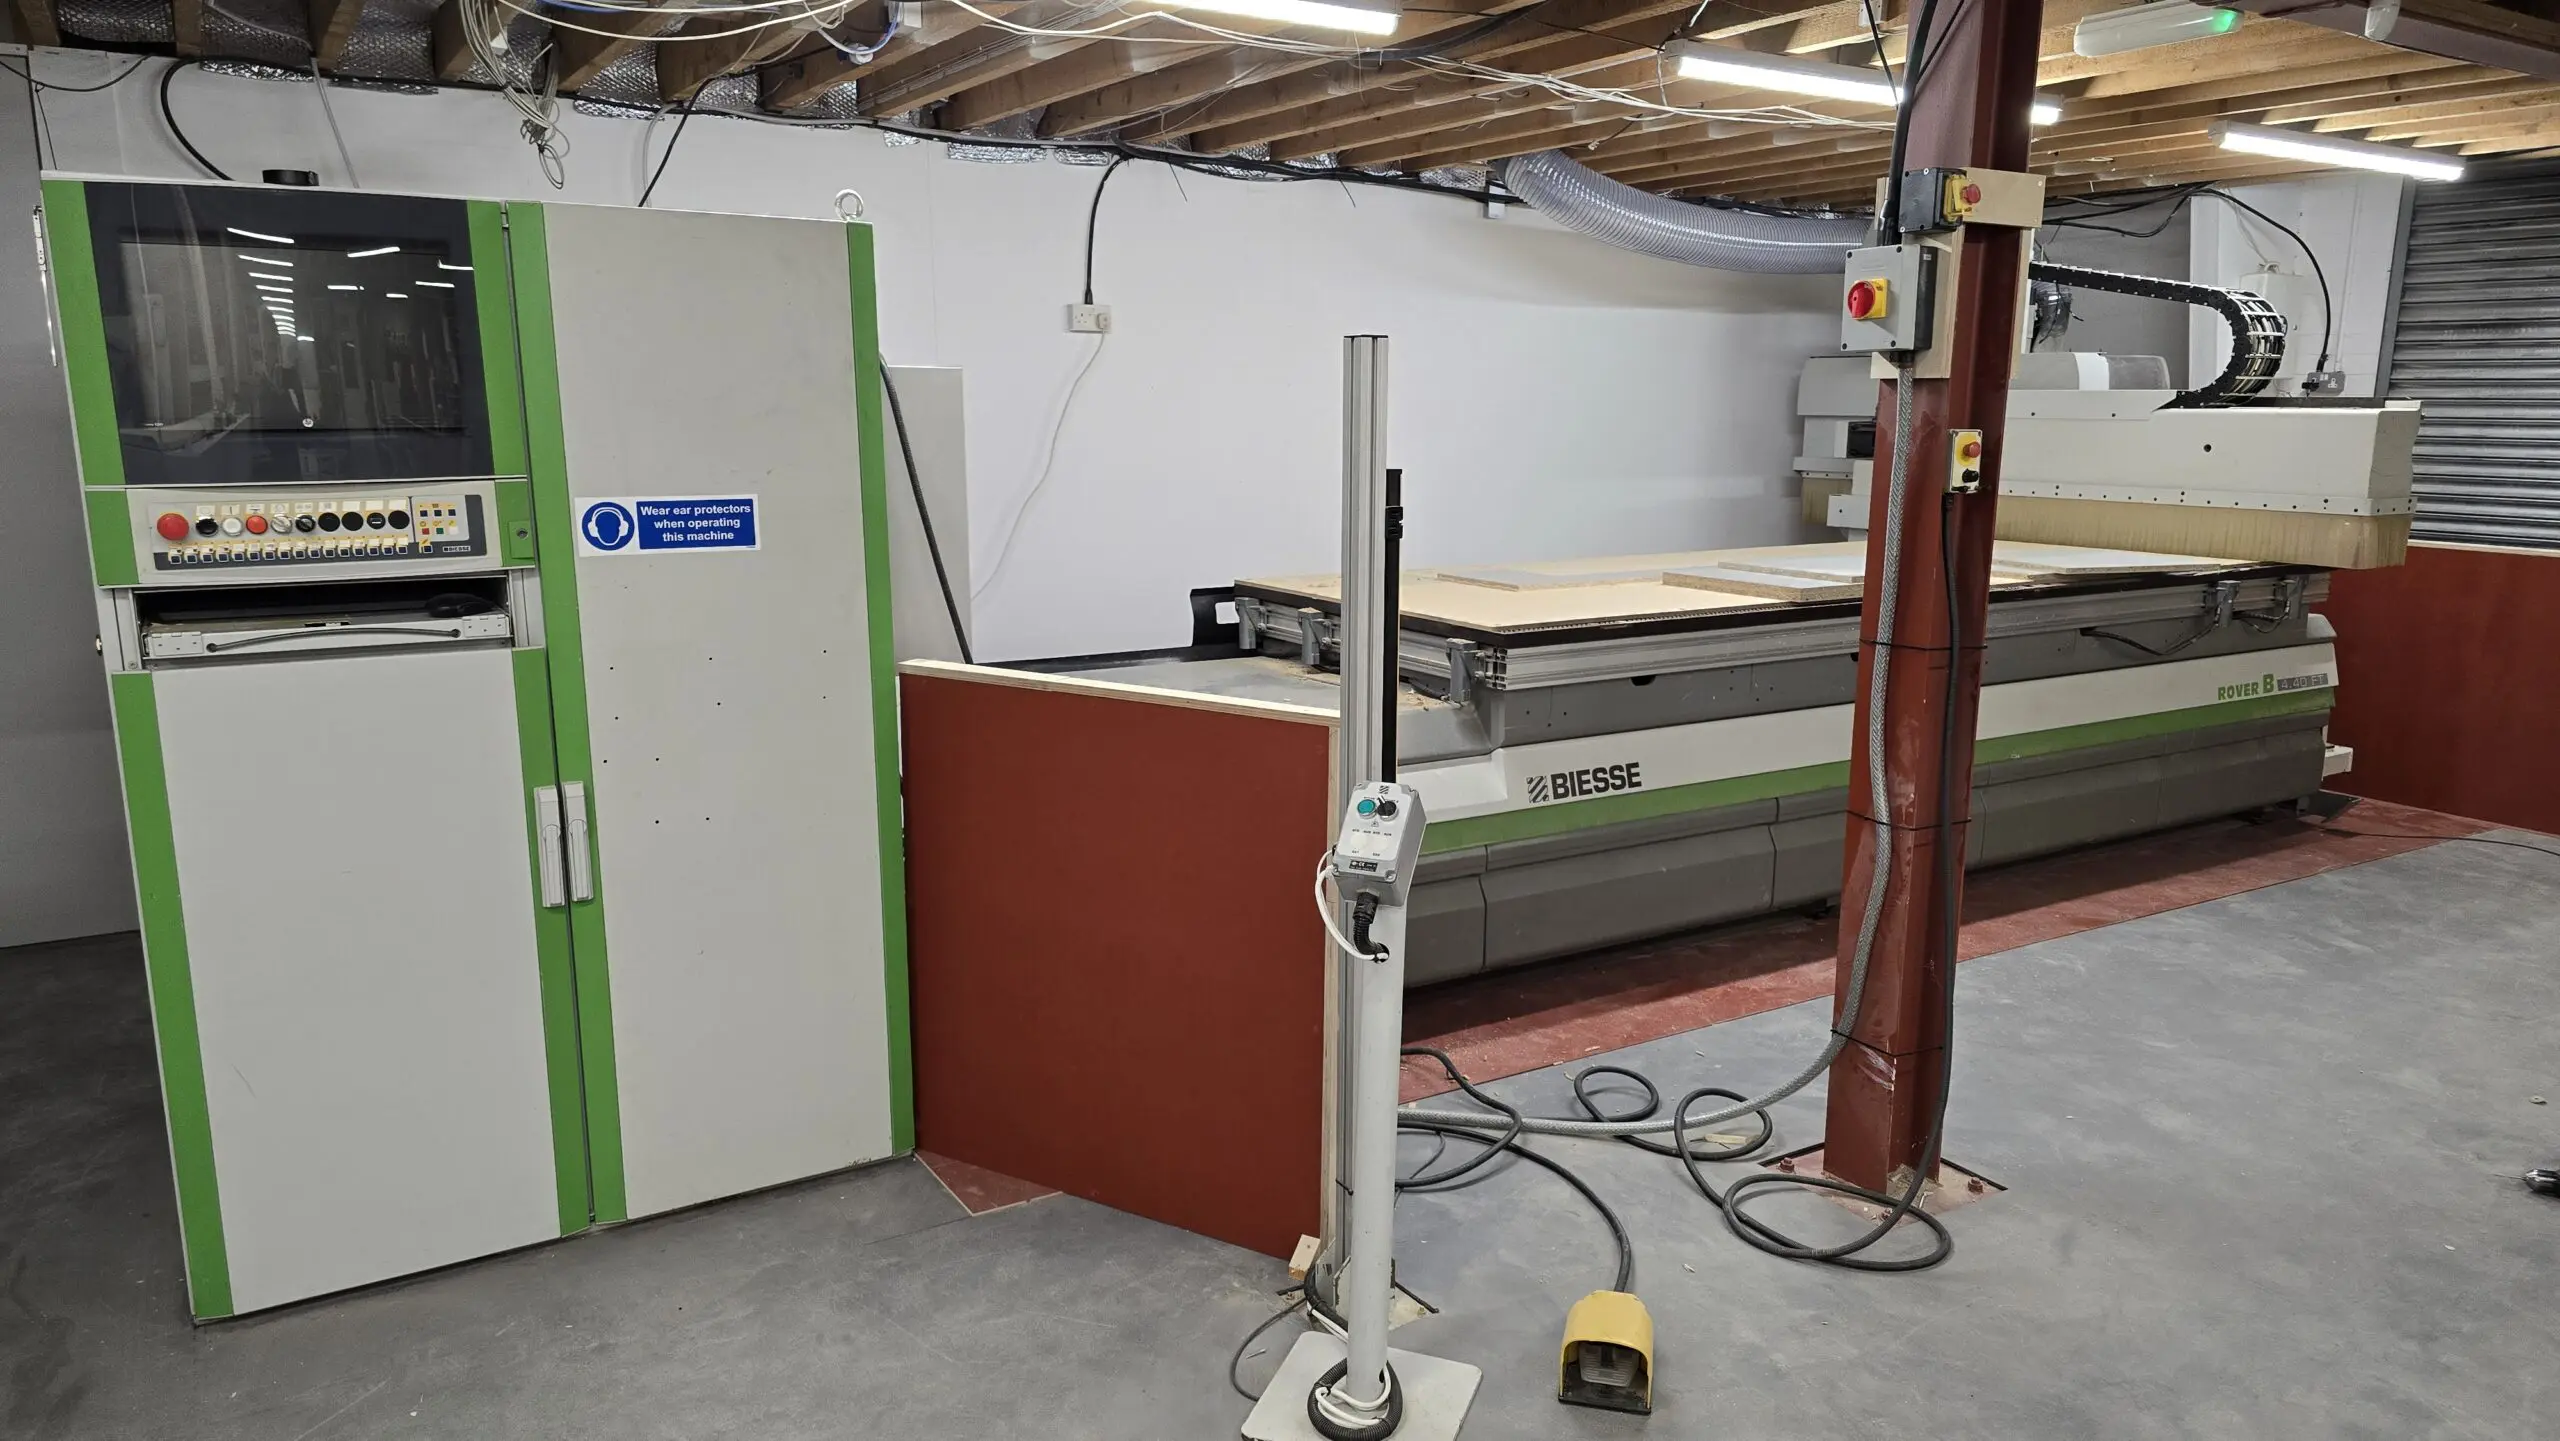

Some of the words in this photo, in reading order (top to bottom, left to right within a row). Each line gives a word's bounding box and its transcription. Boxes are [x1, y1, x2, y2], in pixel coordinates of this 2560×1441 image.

[640, 505, 670, 516] Wear
[673, 507, 691, 516] ear
[694, 504, 751, 516] protectors
[654, 519, 685, 529] when
[688, 518, 741, 530] operating
[662, 532, 684, 542] this
[687, 531, 735, 541] machine
[2218, 682, 2259, 700] ROVER
[2263, 674, 2275, 692] B
[1551, 762, 1642, 799] BIESSE
